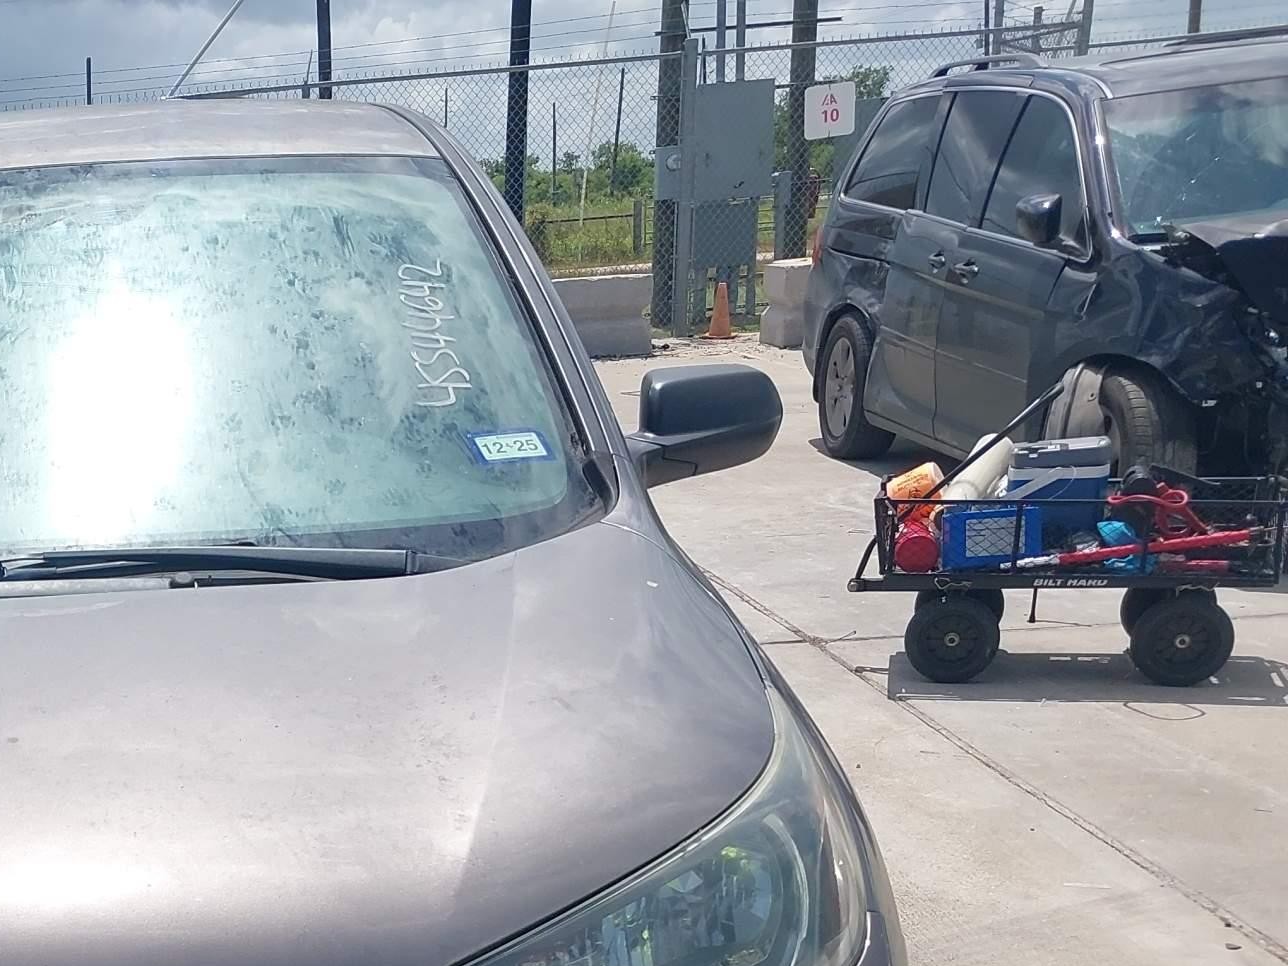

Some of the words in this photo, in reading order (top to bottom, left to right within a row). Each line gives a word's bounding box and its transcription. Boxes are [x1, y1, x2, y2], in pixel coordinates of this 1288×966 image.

[821, 108, 840, 123] 10
[397, 257, 473, 407] 45544642
[1033, 578, 1064, 587] BILT
